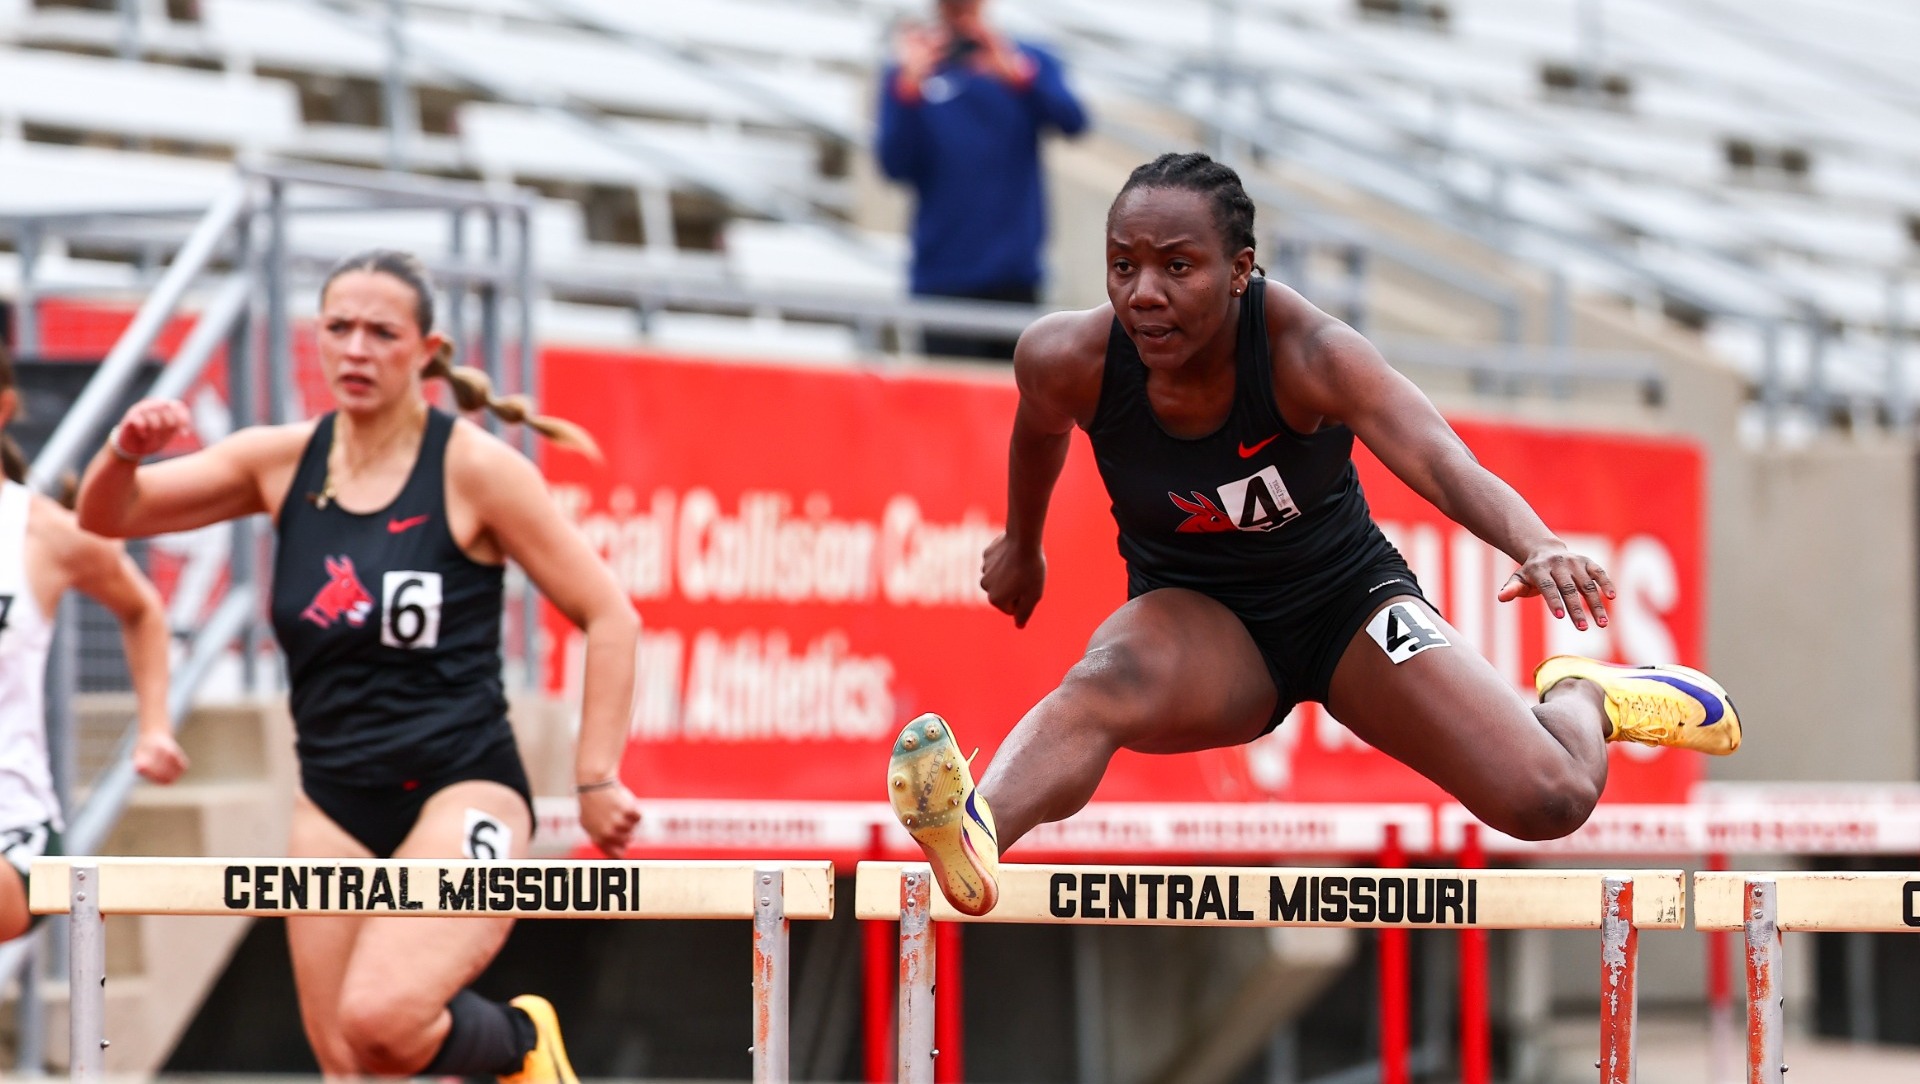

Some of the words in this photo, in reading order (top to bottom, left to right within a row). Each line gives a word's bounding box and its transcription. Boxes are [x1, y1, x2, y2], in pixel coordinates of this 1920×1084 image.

[1239, 476, 1299, 529] 4
[677, 486, 879, 603] Collision
[881, 492, 1006, 607] Cent
[390, 578, 425, 644] 6
[1387, 605, 1446, 652] 4
[684, 627, 897, 743] Athletics
[470, 820, 497, 859] 6
[224, 866, 423, 911] CENTRAL
[439, 867, 640, 912] MISSOURI
[1050, 873, 1254, 921] CENTRAL
[1269, 876, 1477, 924] MISSOURI
